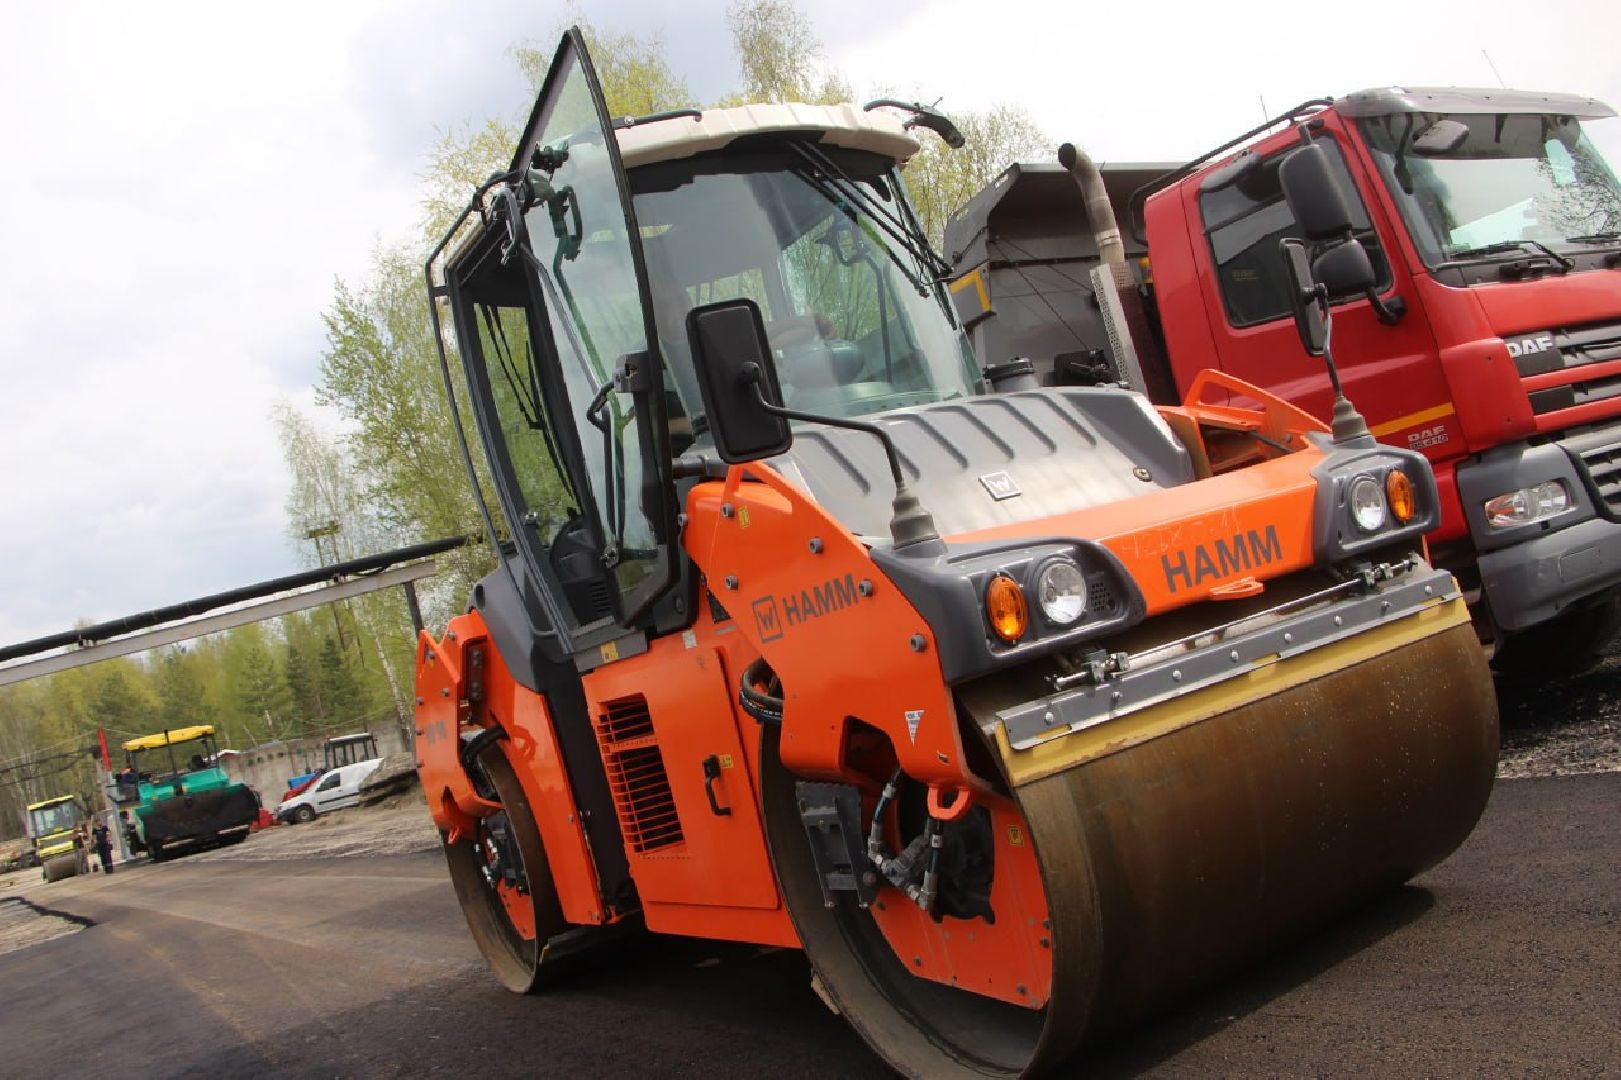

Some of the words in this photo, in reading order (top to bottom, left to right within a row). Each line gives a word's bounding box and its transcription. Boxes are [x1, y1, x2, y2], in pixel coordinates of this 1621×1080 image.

[1505, 336, 1553, 358] DAF
[1408, 425, 1445, 442] DAF
[1161, 525, 1282, 592] HAMM
[783, 573, 858, 626] HAMM
